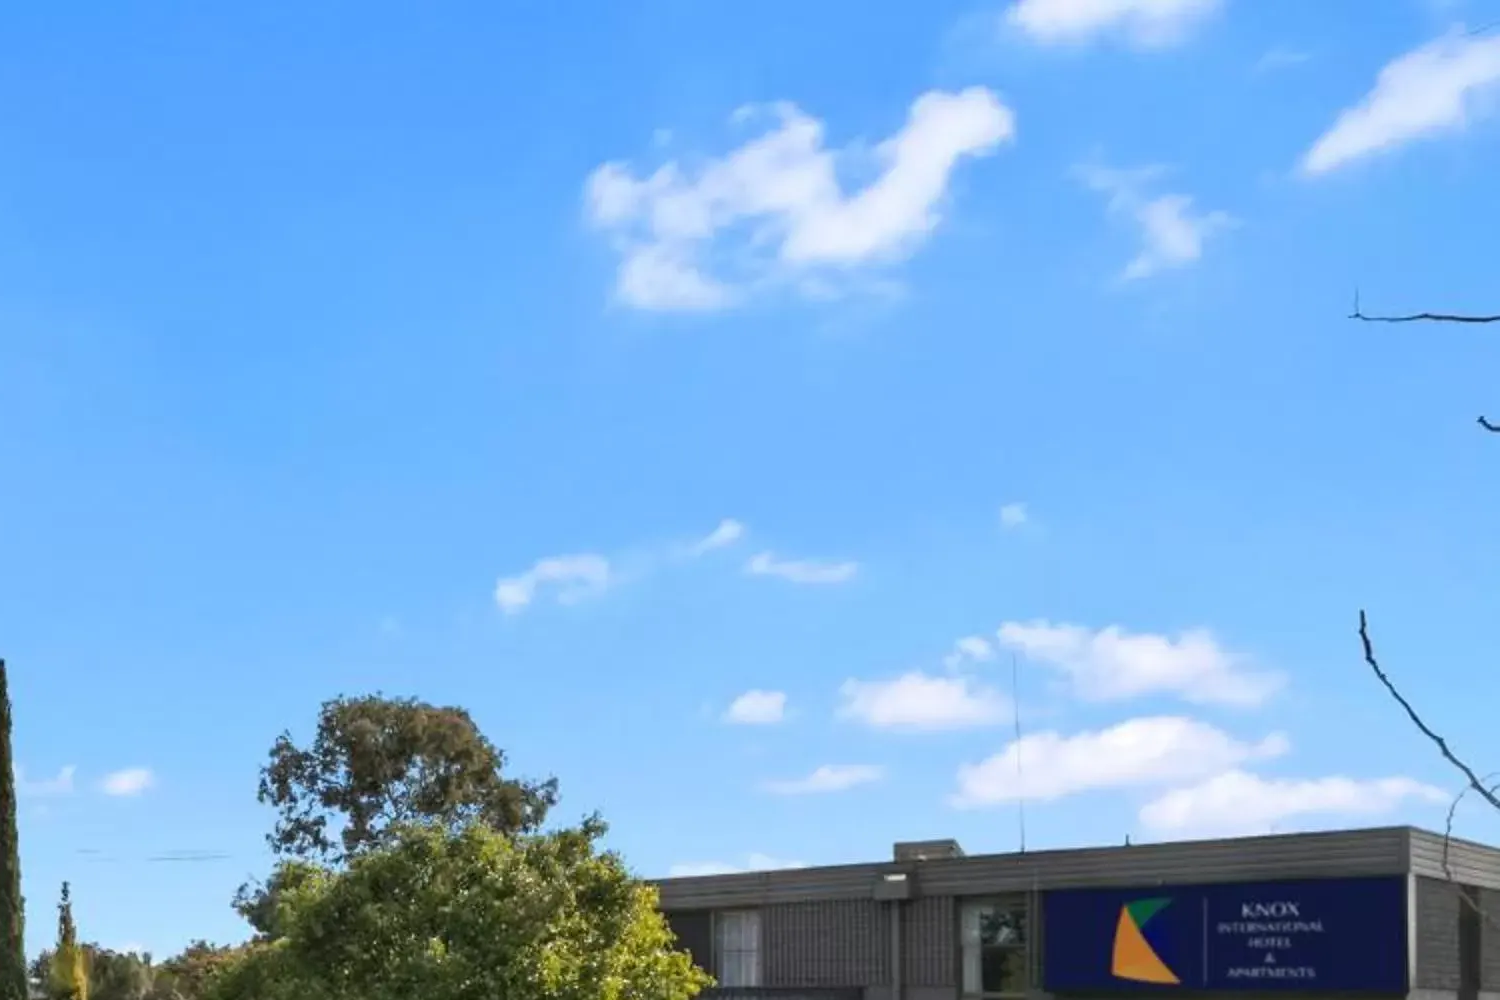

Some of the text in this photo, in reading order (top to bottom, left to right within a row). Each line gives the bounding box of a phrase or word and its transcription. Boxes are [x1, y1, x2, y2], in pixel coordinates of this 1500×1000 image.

[1241, 901, 1300, 918] KNOX
[1217, 919, 1325, 934] INTERNATIONAL
[1247, 936, 1292, 948] HOTEL
[1227, 966, 1316, 978] APARTMENTS
